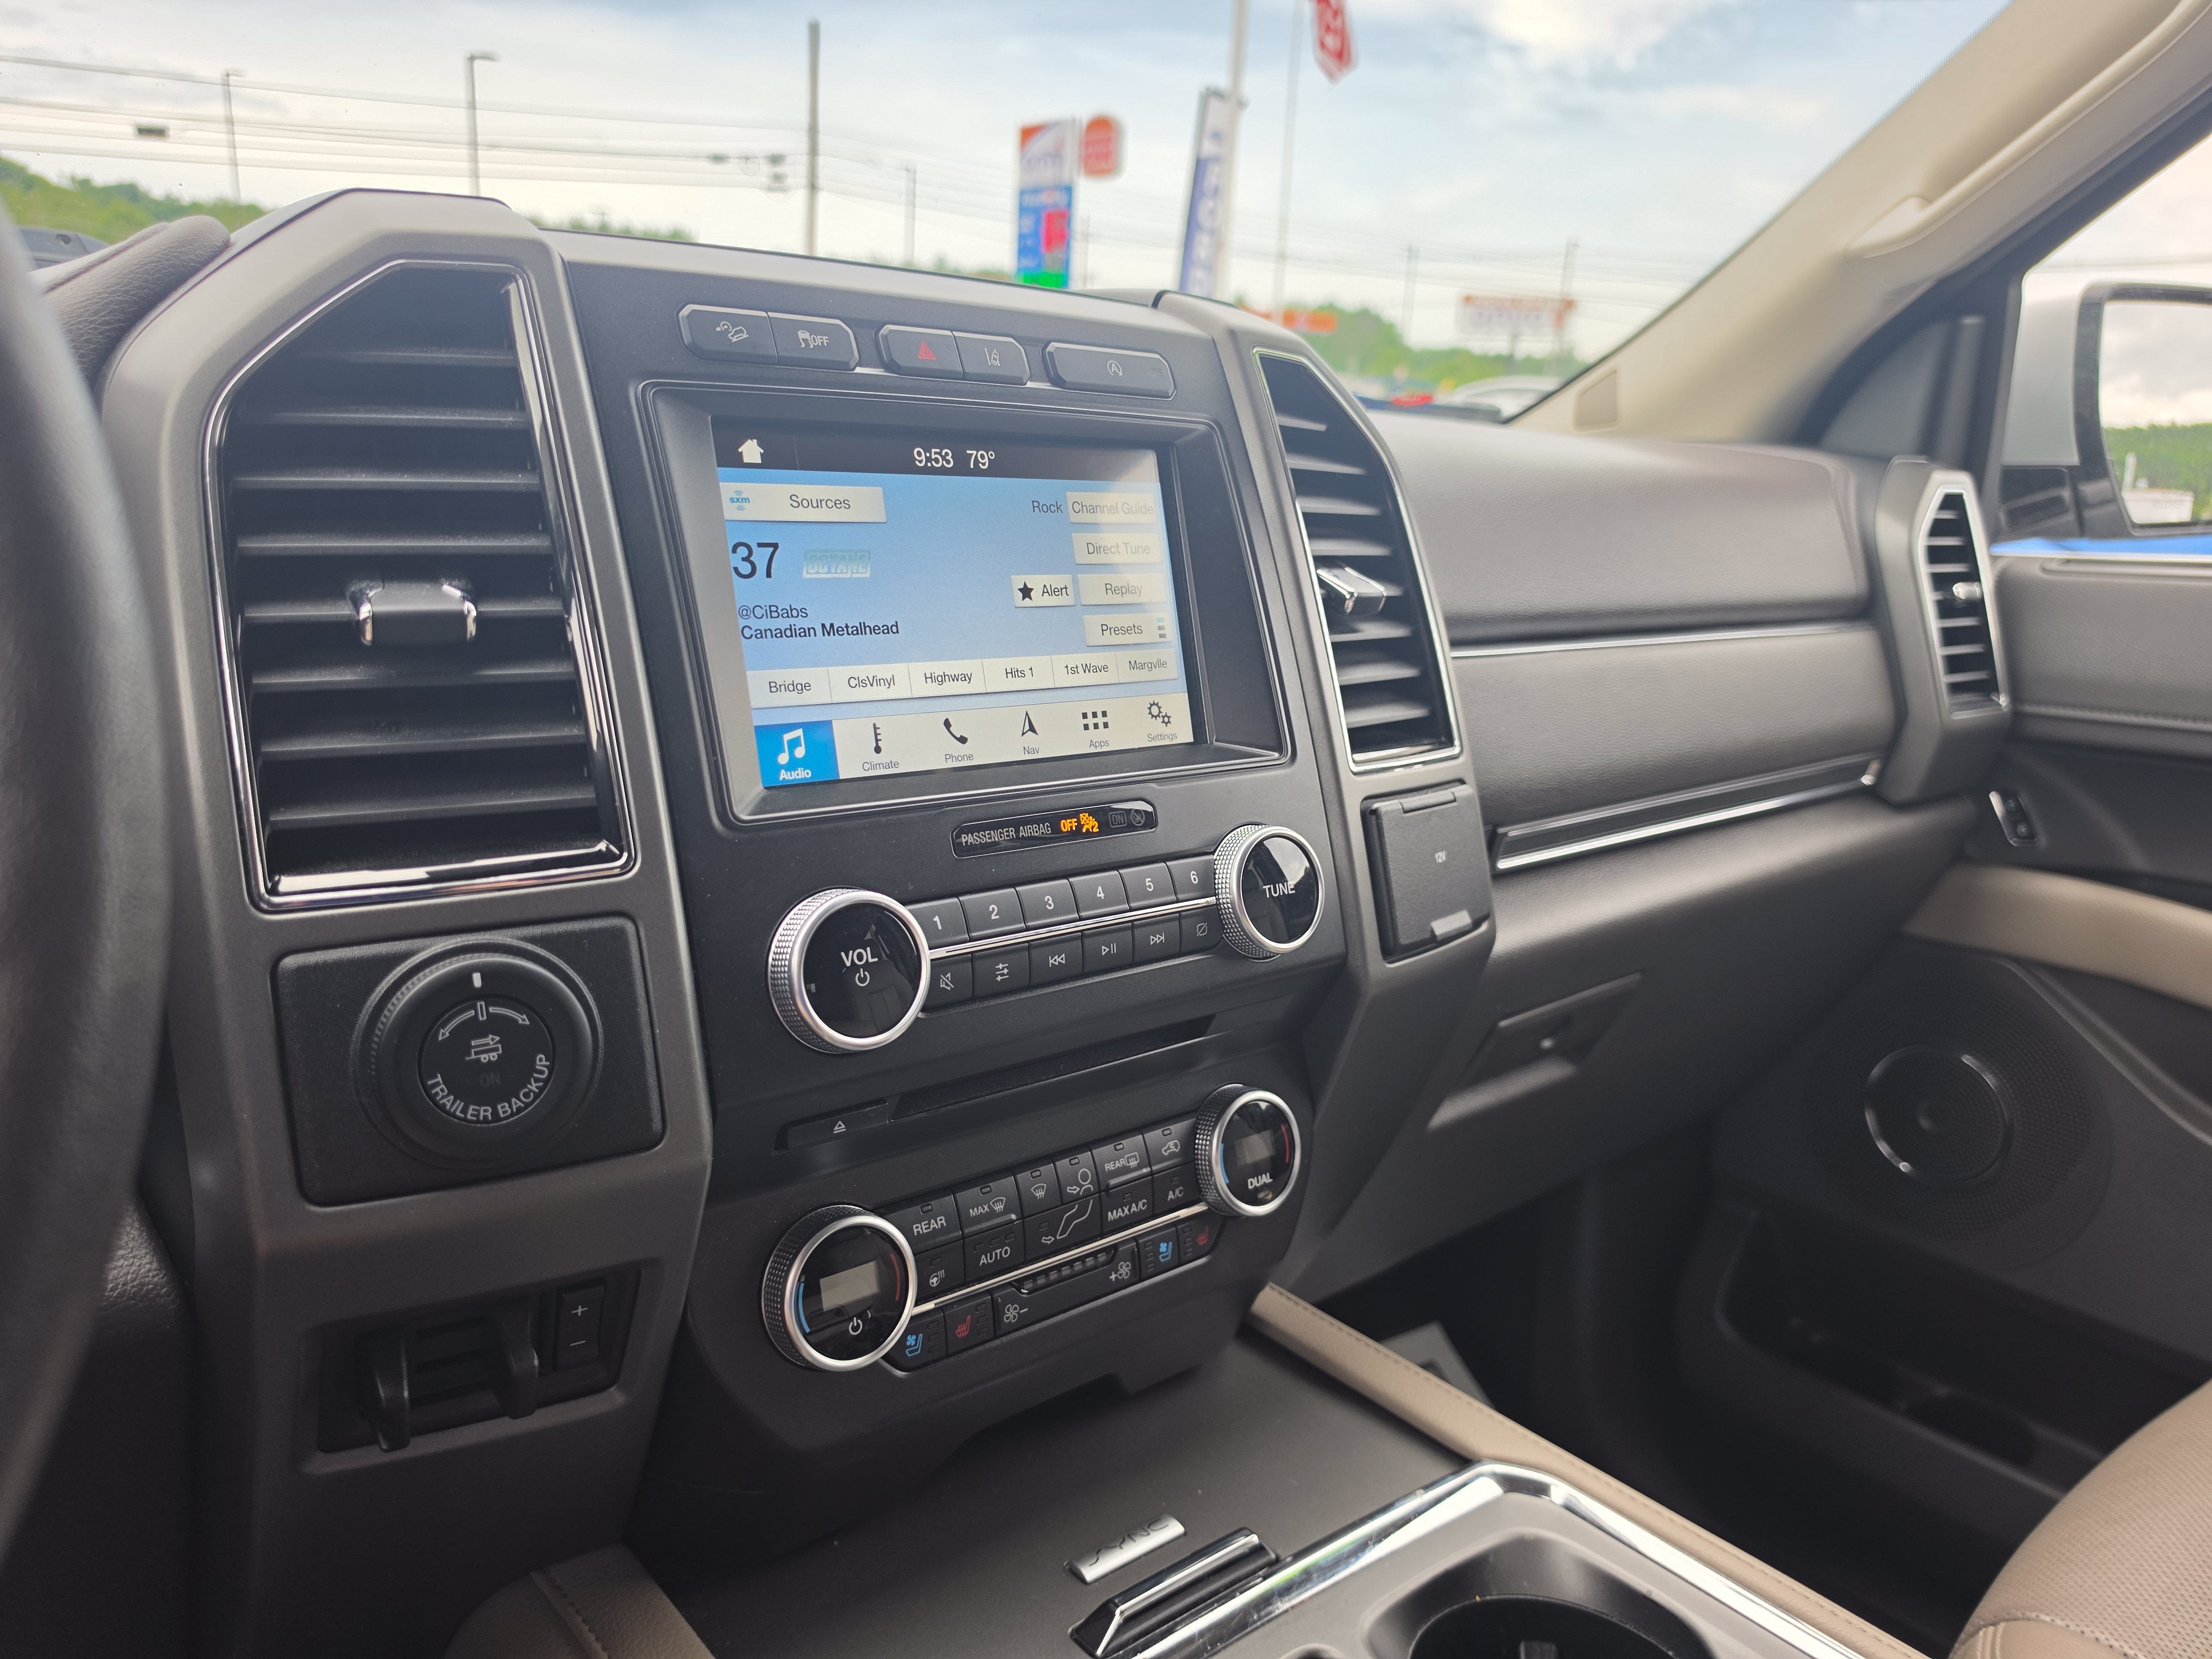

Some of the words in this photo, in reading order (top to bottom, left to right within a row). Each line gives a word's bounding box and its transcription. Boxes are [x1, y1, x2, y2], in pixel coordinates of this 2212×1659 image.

[811, 335, 830, 346] OFF
[914, 447, 954, 468] 9:53
[790, 494, 851, 509] Sources
[1031, 500, 1063, 514] Rock
[1072, 502, 1119, 515] Channel
[1121, 503, 1154, 515] Guide
[1086, 542, 1120, 555] Direct
[1121, 543, 1151, 555] Tune
[732, 541, 780, 579] 37
[1041, 583, 1070, 597] Alert
[1104, 583, 1143, 598] Replay
[738, 604, 808, 620] @CiBabs
[741, 624, 817, 640] Canadian
[821, 620, 900, 637] Metalhead
[1100, 624, 1143, 636] Presets
[1064, 665, 1079, 675] 1st
[1081, 663, 1109, 674] Wave
[1129, 659, 1167, 672] Margvlle
[924, 672, 973, 686] Highway
[1005, 667, 1026, 679] Hits
[1028, 667, 1034, 677] 1
[769, 680, 812, 695] Bridge
[848, 674, 895, 689] ClsVinyl
[1088, 738, 1110, 749] Apps
[1147, 732, 1178, 743] Settings
[1023, 745, 1040, 755] Nav
[945, 752, 974, 764] Phone
[862, 759, 900, 772] Climate
[779, 768, 812, 781] Audio
[962, 827, 1016, 846] PASSENGER
[1019, 823, 1051, 838] AIRBAG
[1061, 818, 1077, 832] OFF
[1112, 813, 1124, 825] ON
[1146, 878, 1154, 891] 5
[1191, 871, 1198, 884] 6
[1096, 886, 1105, 899] 4
[1262, 881, 1296, 899] TUNE
[1045, 895, 1054, 910] 3
[989, 904, 999, 920] 2
[933, 916, 942, 930] 1
[841, 947, 878, 967] VOL
[427, 1073, 492, 1120] TRAILER
[497, 1054, 550, 1118] BACKUP
[1105, 1158, 1125, 1172] REAR
[1248, 1172, 1273, 1189] DUAL
[1167, 1187, 1184, 1201] A/C
[969, 1204, 989, 1217] MAX
[1108, 1205, 1130, 1222] MAX
[1130, 1199, 1147, 1213] A/C
[913, 1216, 946, 1236] REAR
[979, 1246, 1010, 1266] AUTO
[1089, 1517, 1170, 1567] SYNC
